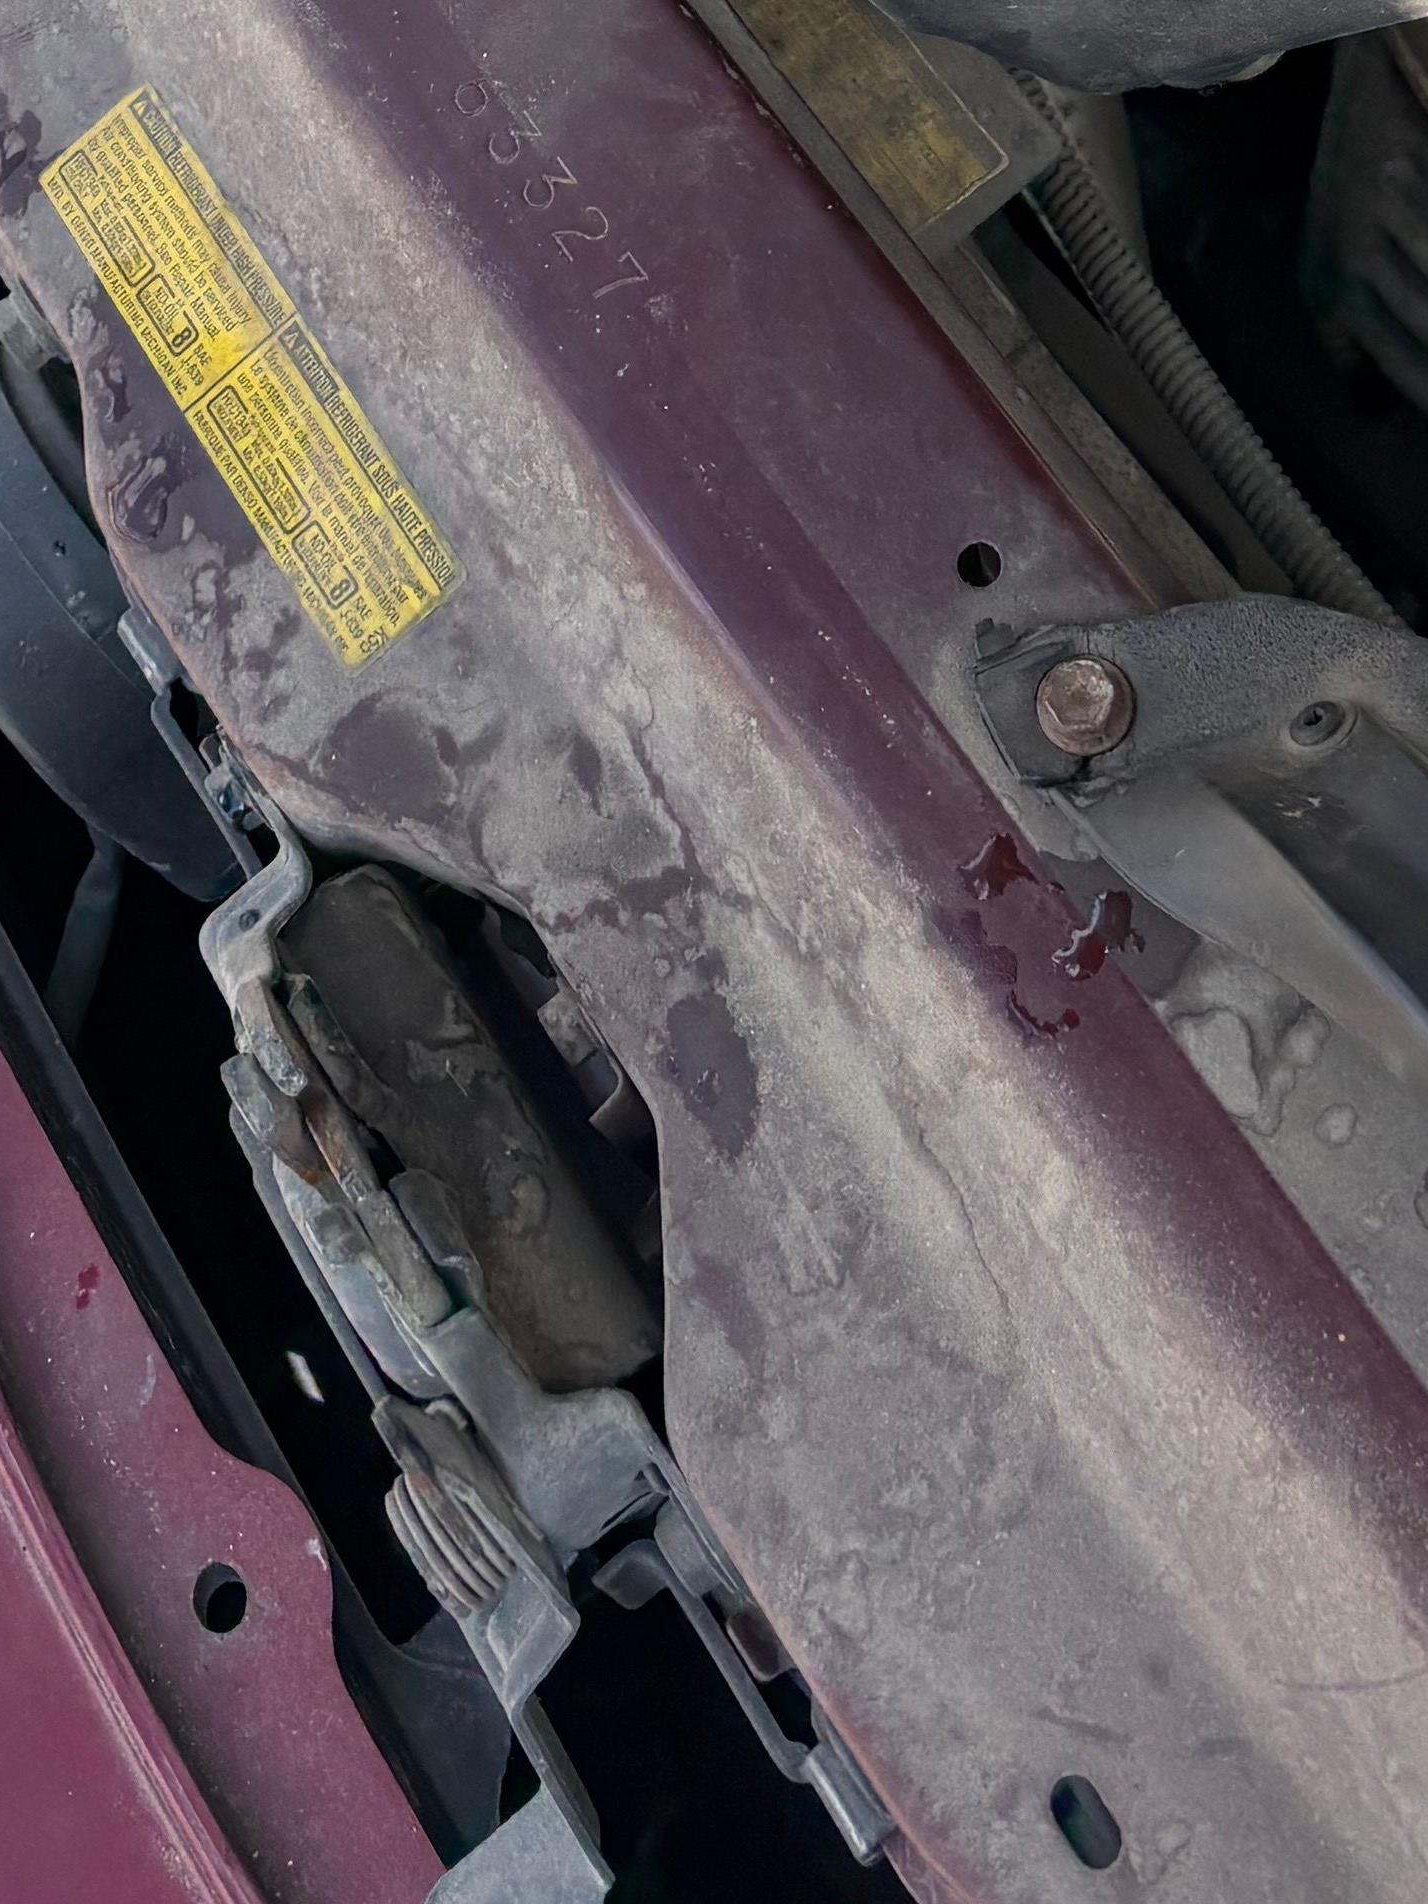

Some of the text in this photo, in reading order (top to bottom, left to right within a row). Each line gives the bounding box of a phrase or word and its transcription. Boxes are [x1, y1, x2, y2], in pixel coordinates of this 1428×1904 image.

[110, 113, 147, 163] Improper
[163, 192, 198, 240] methods
[189, 237, 212, 266] may
[141, 107, 179, 157] CAUTION
[245, 268, 287, 325] PRESSURE
[166, 262, 196, 301] Repair
[170, 234, 200, 275] should
[202, 283, 238, 333] serviced
[191, 341, 213, 368] SAE
[236, 370, 254, 394] une
[247, 390, 284, 441] personne
[293, 342, 336, 401] ATTENTION
[370, 461, 399, 500] SOUS
[390, 492, 422, 535] HAUTE
[412, 527, 456, 588] PRESSION
